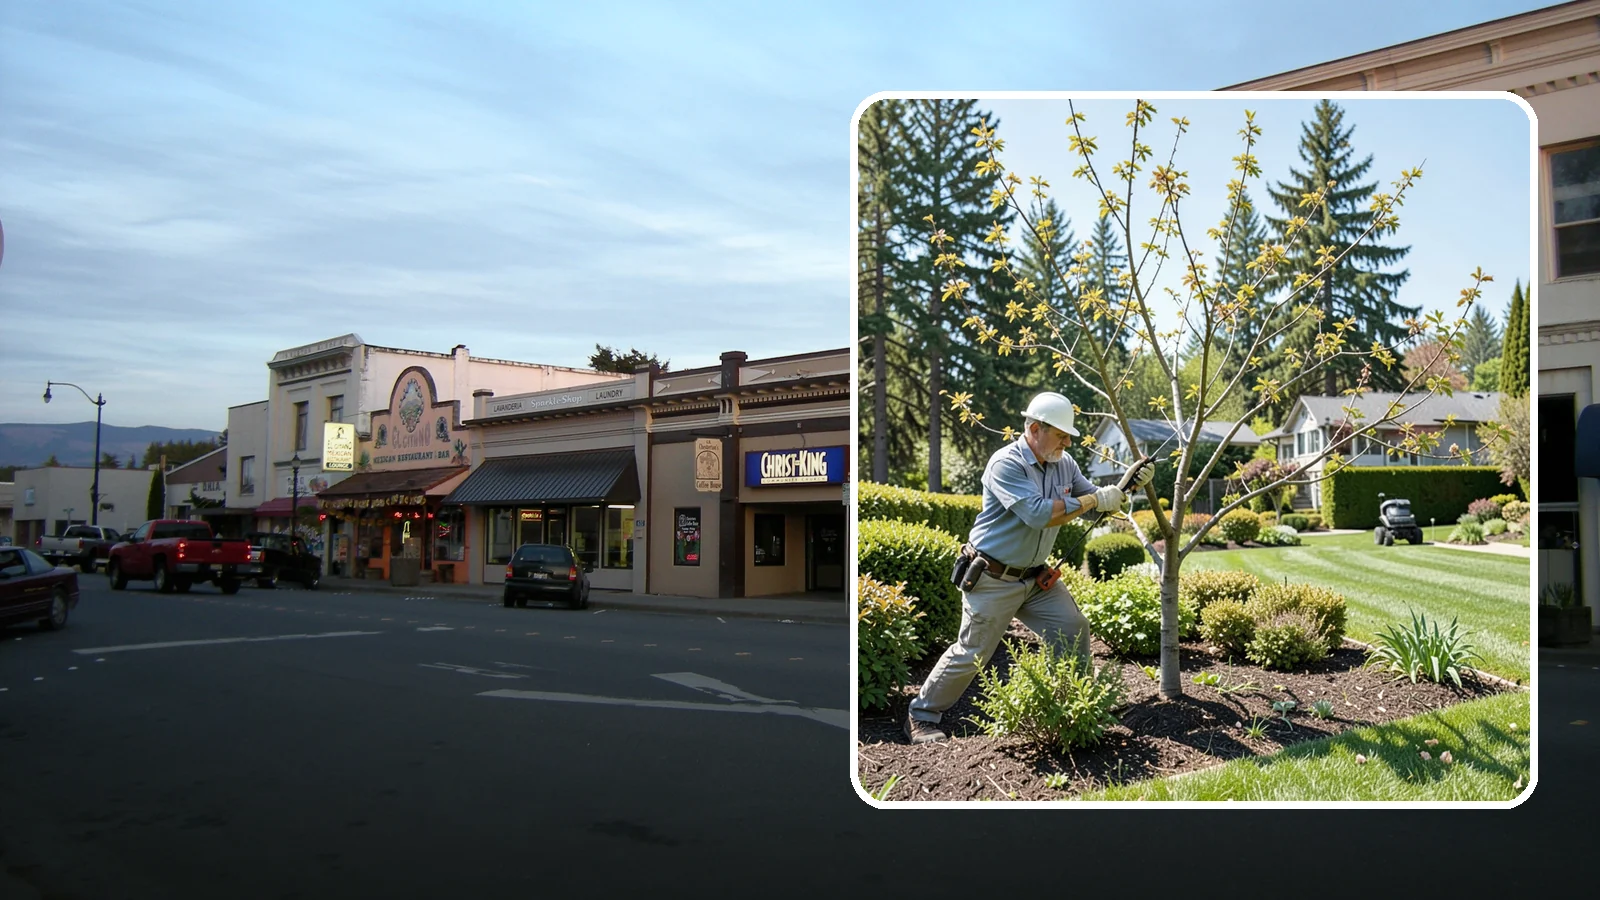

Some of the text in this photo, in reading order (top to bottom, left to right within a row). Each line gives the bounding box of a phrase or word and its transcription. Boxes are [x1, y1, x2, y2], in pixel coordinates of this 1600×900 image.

[493, 402, 523, 412] LAVANDERIA
[595, 389, 623, 400] LAUNDRY
[373, 450, 450, 464] MEXICAN RESTAURANT BAR
[761, 450, 827, 478] CHRIST KING
